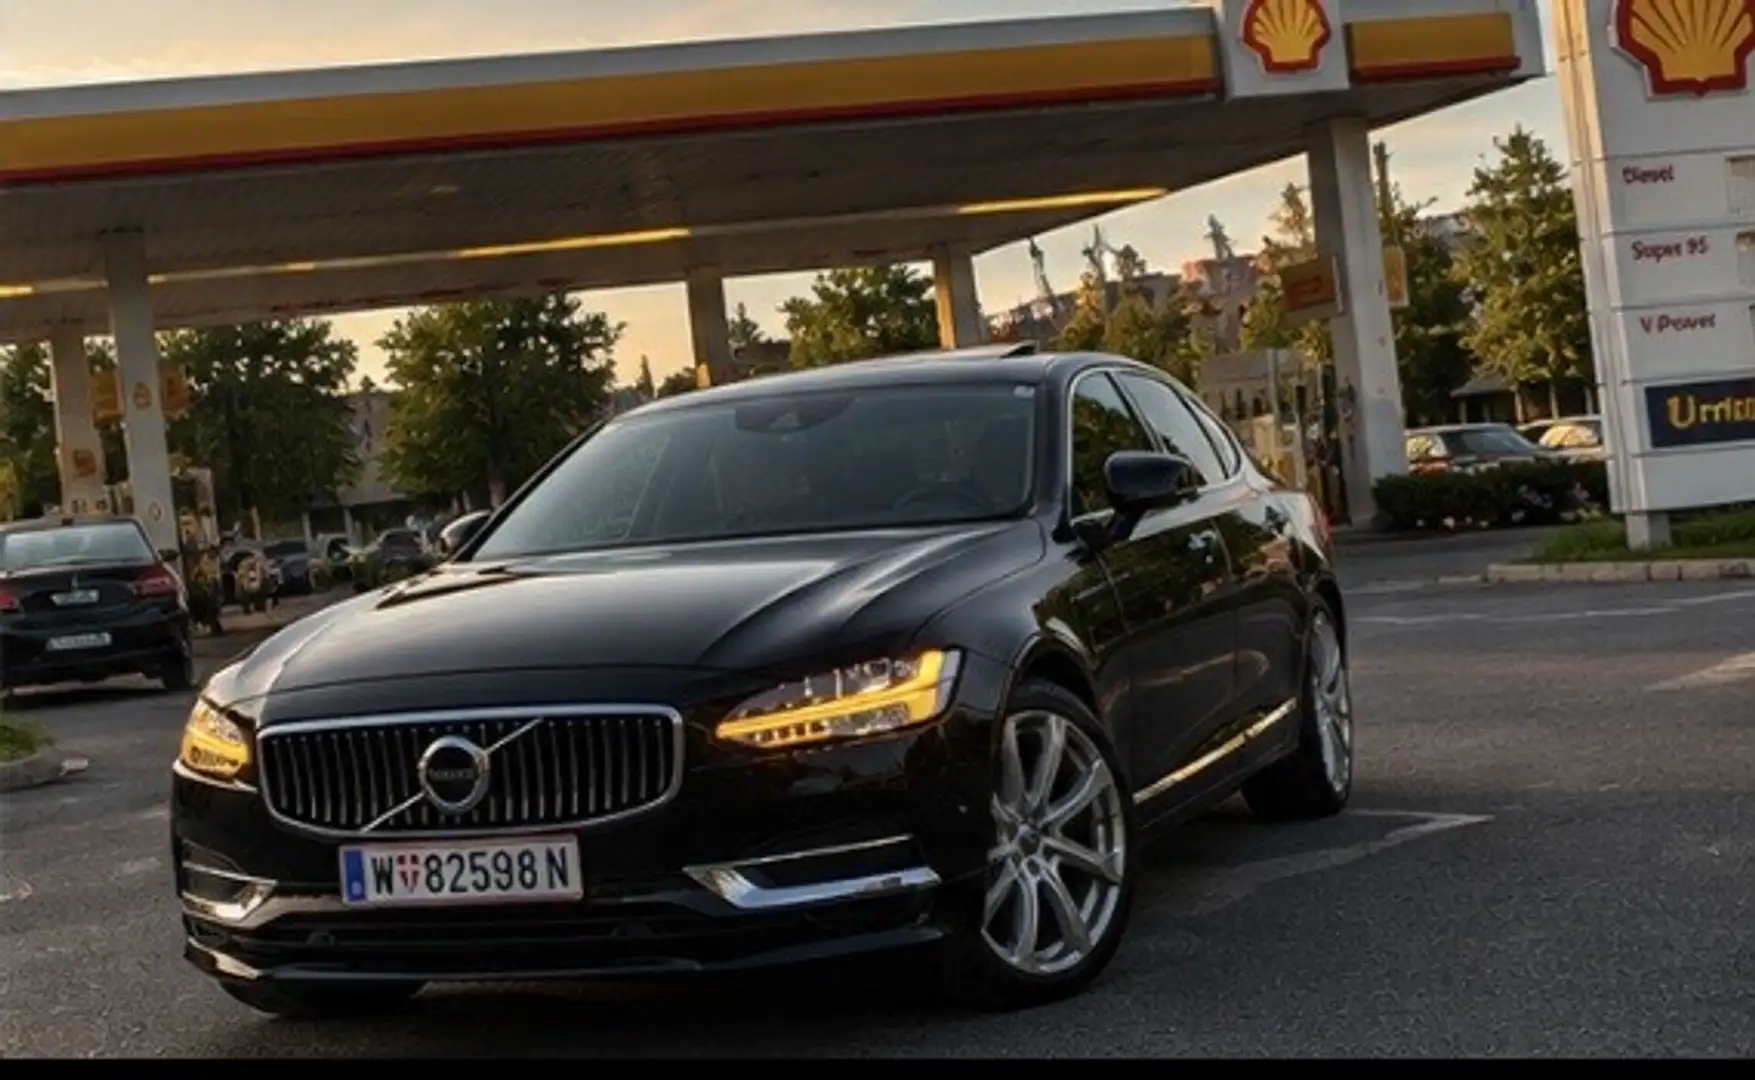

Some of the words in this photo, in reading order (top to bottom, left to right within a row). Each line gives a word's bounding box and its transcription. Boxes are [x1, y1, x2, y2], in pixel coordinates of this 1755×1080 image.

[371, 856, 394, 895] W
[424, 849, 538, 893] 82598
[546, 846, 569, 889] N
